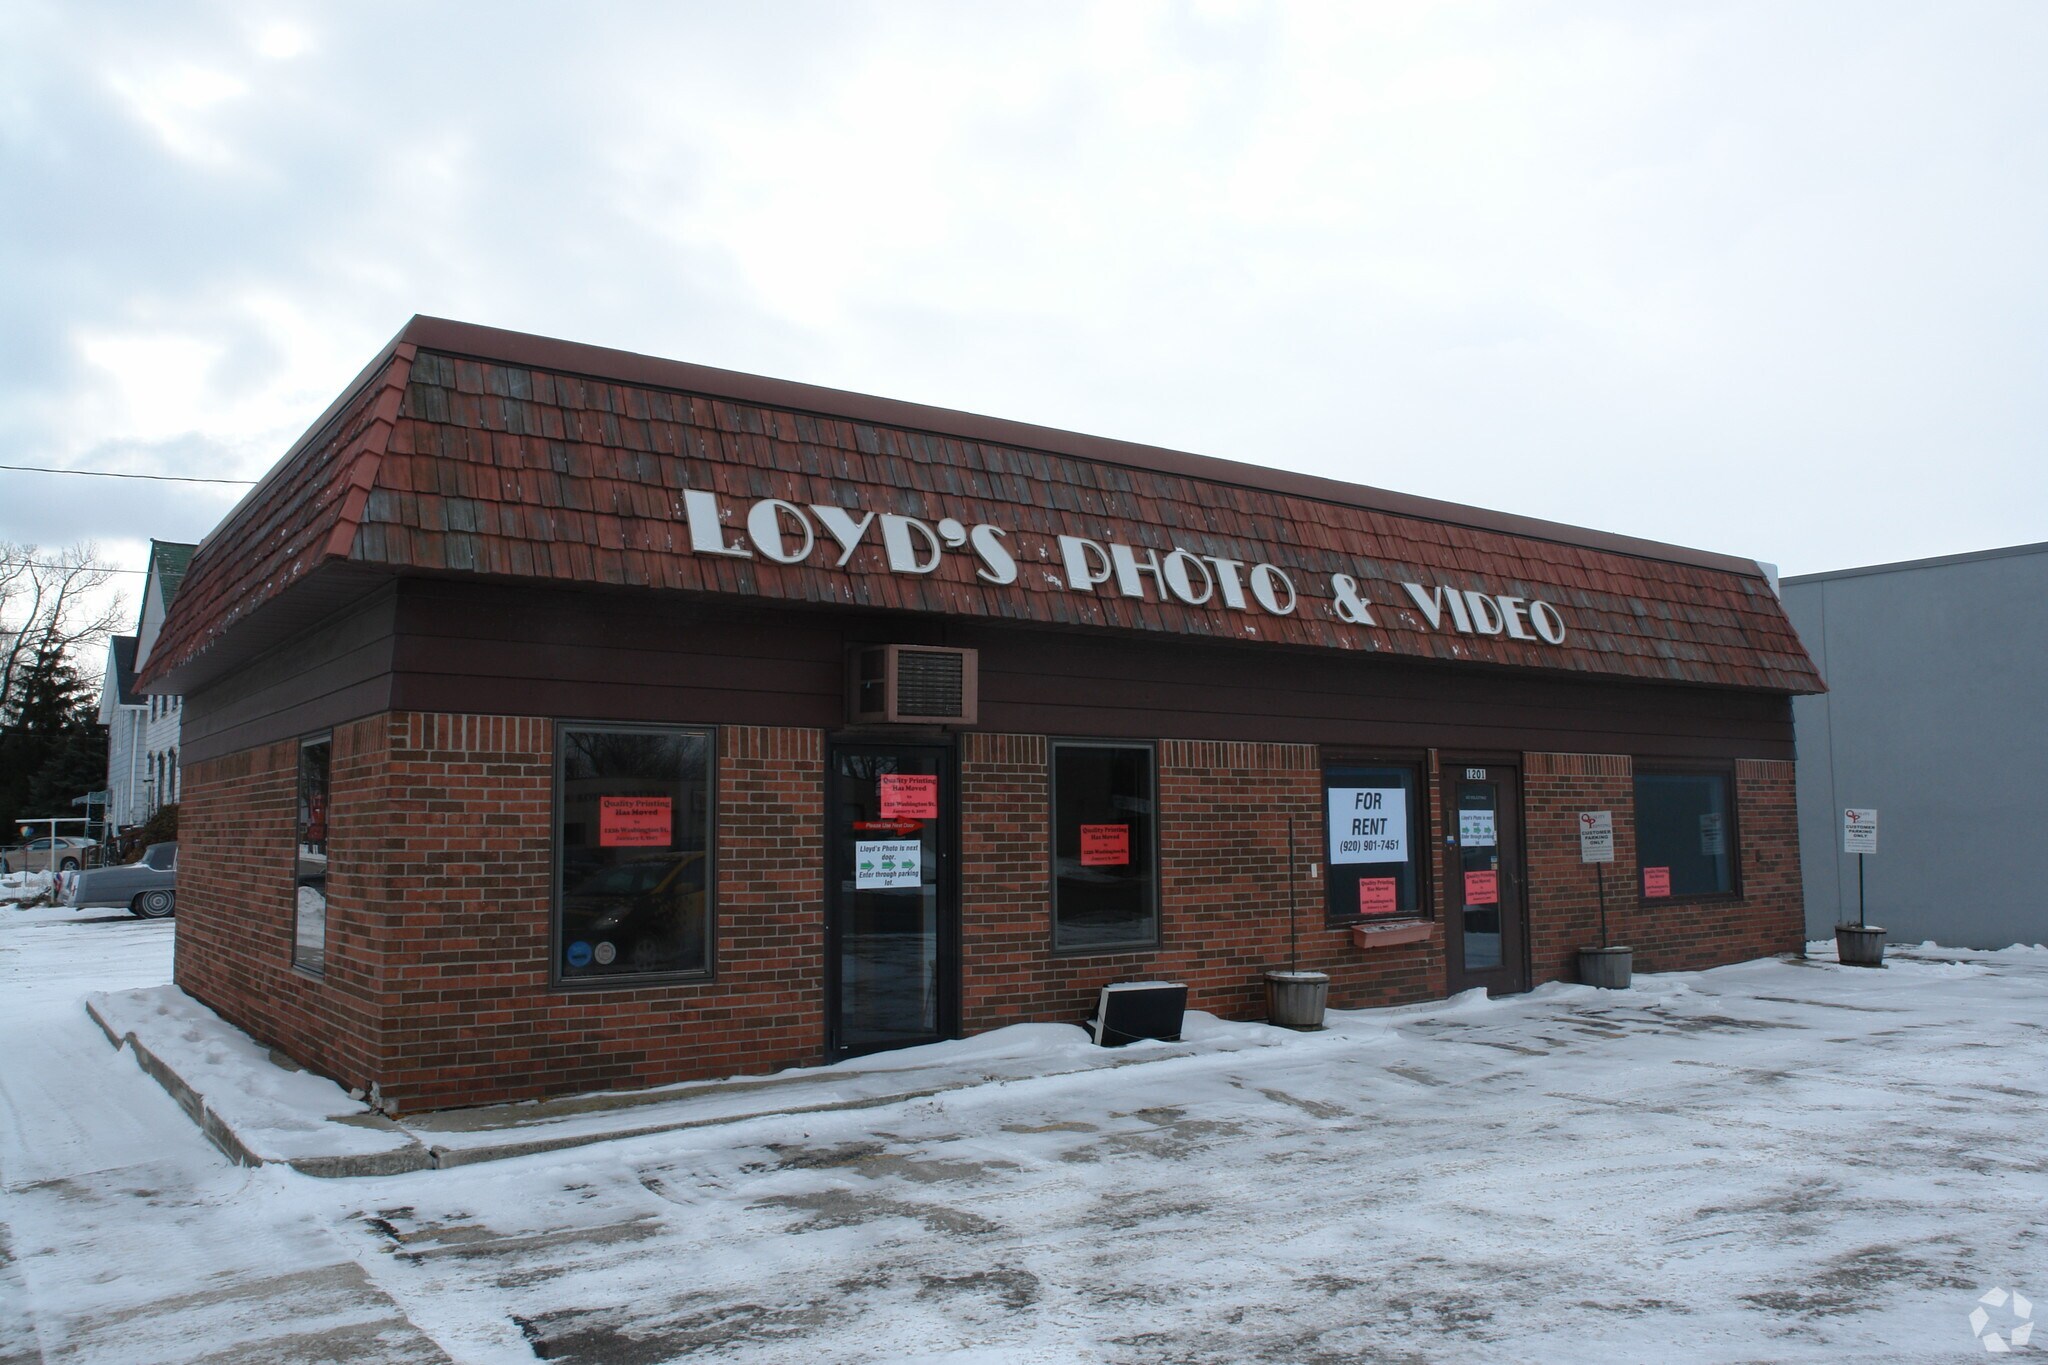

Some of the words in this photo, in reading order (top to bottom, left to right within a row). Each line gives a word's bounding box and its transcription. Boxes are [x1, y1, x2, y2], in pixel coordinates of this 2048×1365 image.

[682, 488, 1018, 586] LOYD'S
[1056, 534, 1297, 616] PHOTO
[1331, 572, 1377, 627] &
[1401, 581, 1567, 646] VIDEO
[1467, 769, 1485, 779] 1201
[883, 777, 907, 785] Quality
[908, 777, 937, 785] Printing
[604, 800, 634, 808] Quality
[635, 800, 670, 808] Printing
[1355, 792, 1382, 810] FOR
[1352, 817, 1388, 836] RENT
[859, 845, 881, 854] Lloyd's
[1339, 840, 1361, 855] (920)
[1363, 839, 1400, 851] 901-7451
[859, 871, 875, 879] Enter
[875, 871, 897, 879] through
[897, 871, 919, 879] parking
